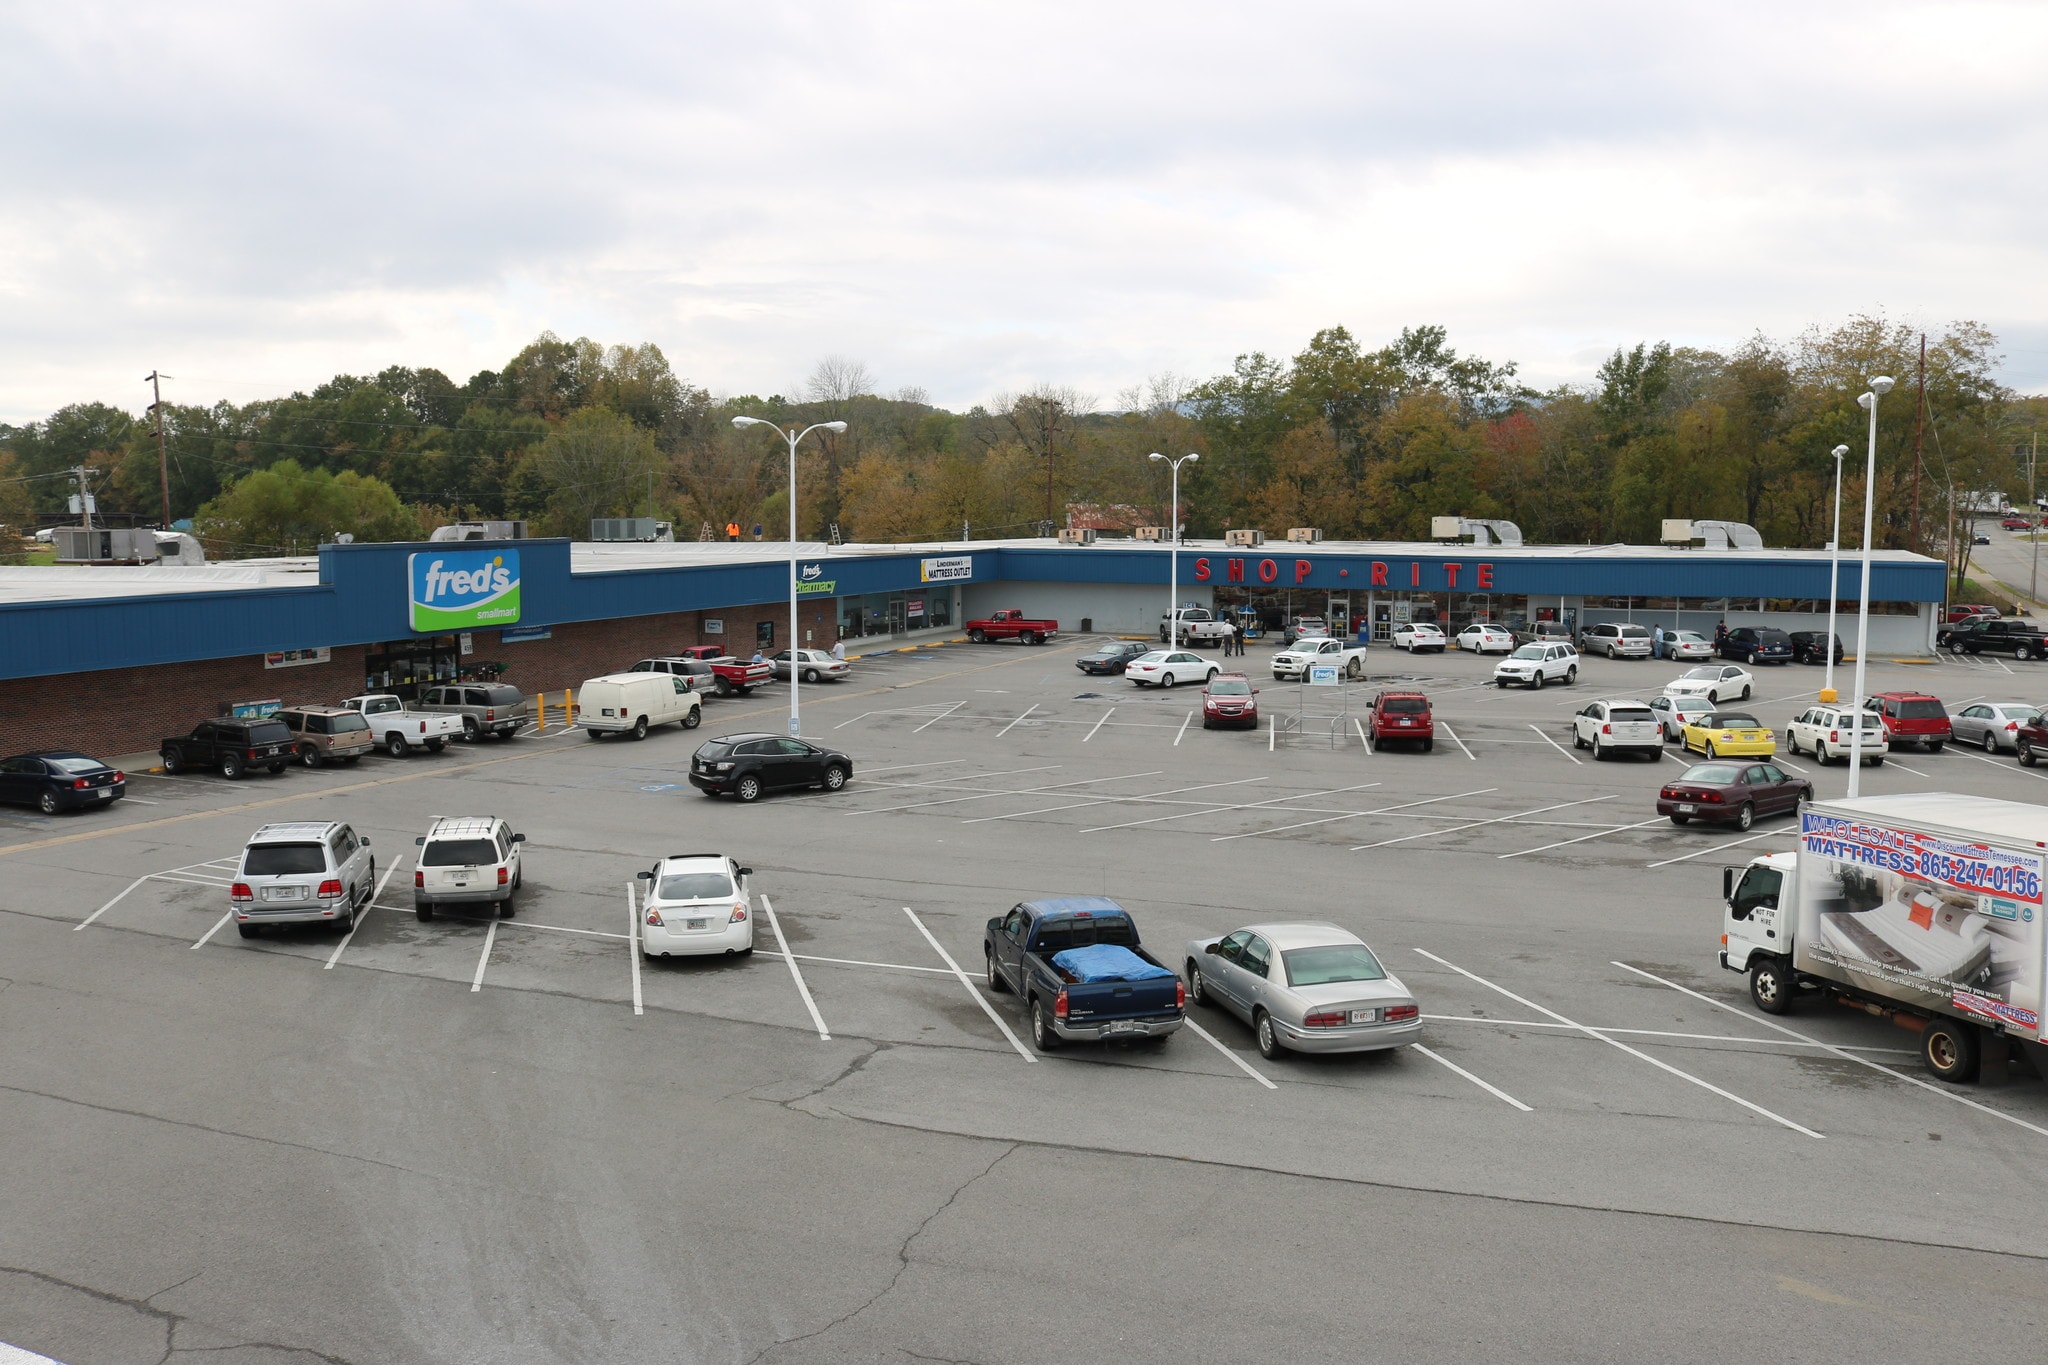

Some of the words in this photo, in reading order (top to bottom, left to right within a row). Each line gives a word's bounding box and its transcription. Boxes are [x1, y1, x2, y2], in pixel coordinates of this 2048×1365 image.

[425, 556, 510, 602] fred's
[928, 569, 953, 579] MATTRESS
[953, 566, 971, 577] OUTLET
[1195, 557, 1312, 583] SHOP
[1371, 561, 1493, 588] RITE
[795, 580, 836, 594] Pharmacy
[477, 607, 516, 619] smallmart
[1806, 815, 1916, 853] WHOLESALE
[1807, 836, 1916, 873] MATTRESS
[1920, 852, 2039, 898] 865-247-0156
[1755, 908, 1765, 916] NOT
[1760, 918, 1772, 926] HIRE
[1808, 952, 1818, 960] the
[1818, 955, 1837, 966] comfort
[1870, 969, 1881, 977] and
[1885, 974, 1899, 984] price
[1900, 977, 1915, 988] that's
[1931, 987, 1945, 997] only
[1870, 957, 1882, 968] help
[1883, 963, 1893, 971] you
[1893, 964, 1908, 975] sleep
[1929, 974, 1940, 984] Get
[1941, 977, 1951, 986] the
[1951, 982, 1972, 994] quality
[1973, 987, 1985, 996] you
[1994, 1003, 2036, 1024] MATTRESS
